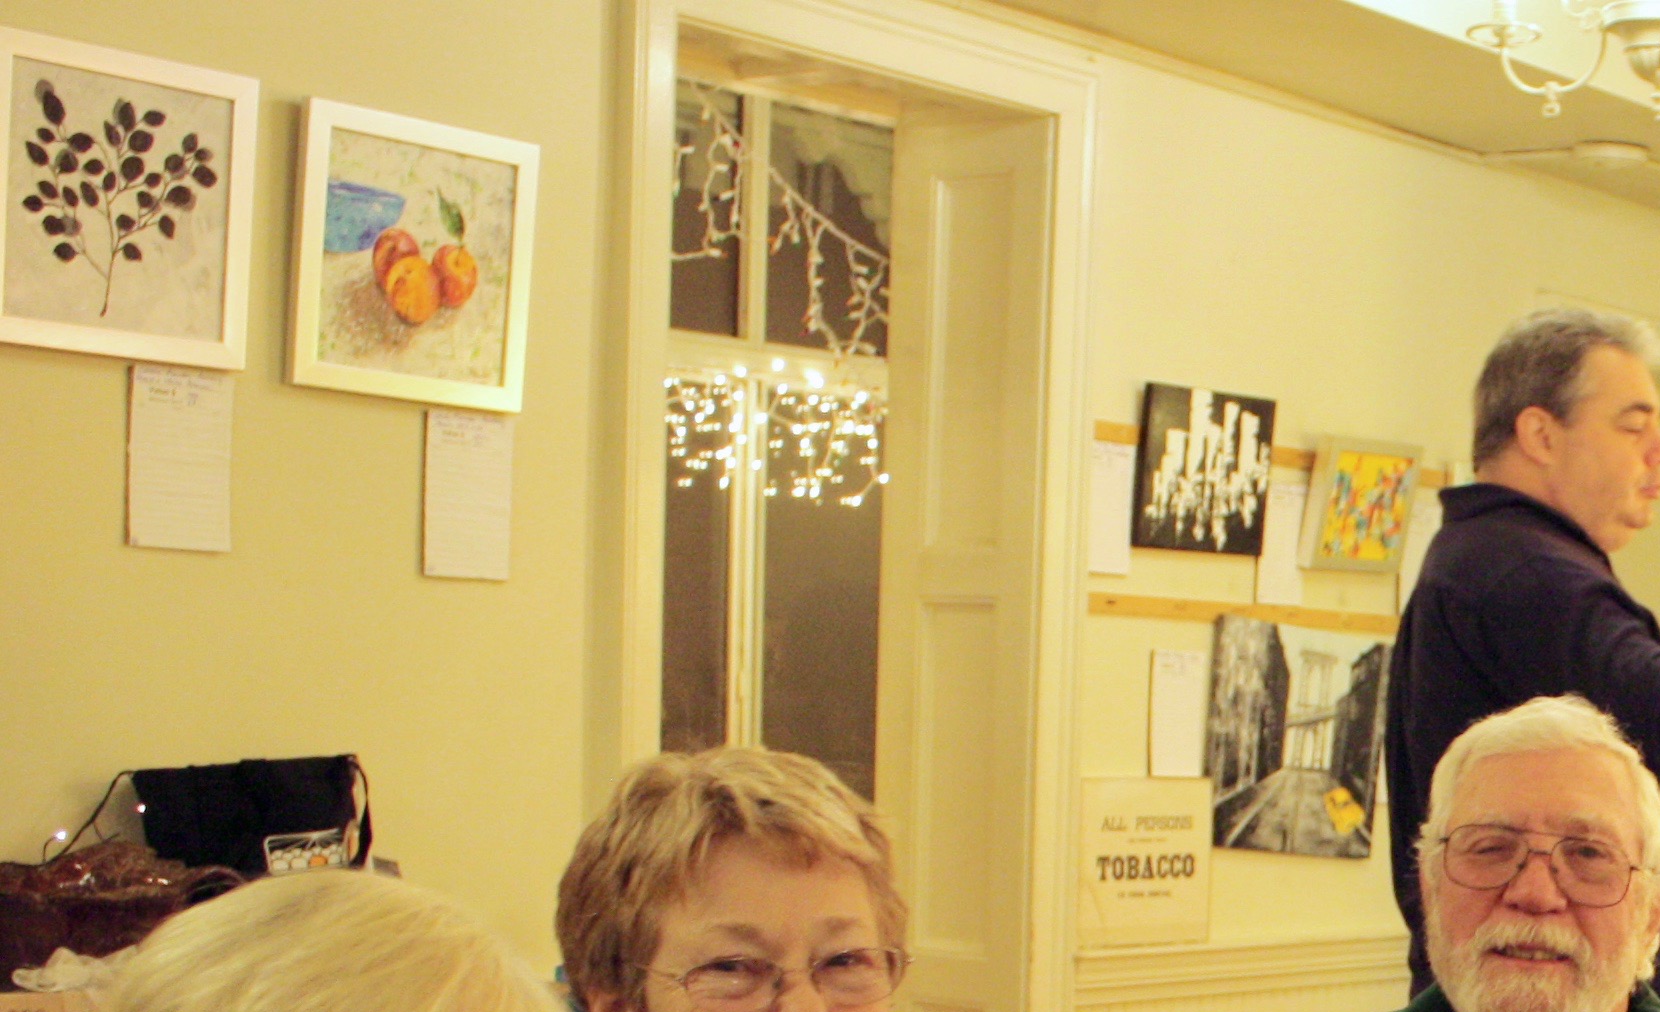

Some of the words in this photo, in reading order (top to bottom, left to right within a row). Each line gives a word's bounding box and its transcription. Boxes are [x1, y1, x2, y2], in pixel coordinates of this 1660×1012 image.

[1101, 816, 1127, 831] ALL
[1136, 815, 1193, 830] PERSONS
[1097, 854, 1195, 881] TOBACCO
